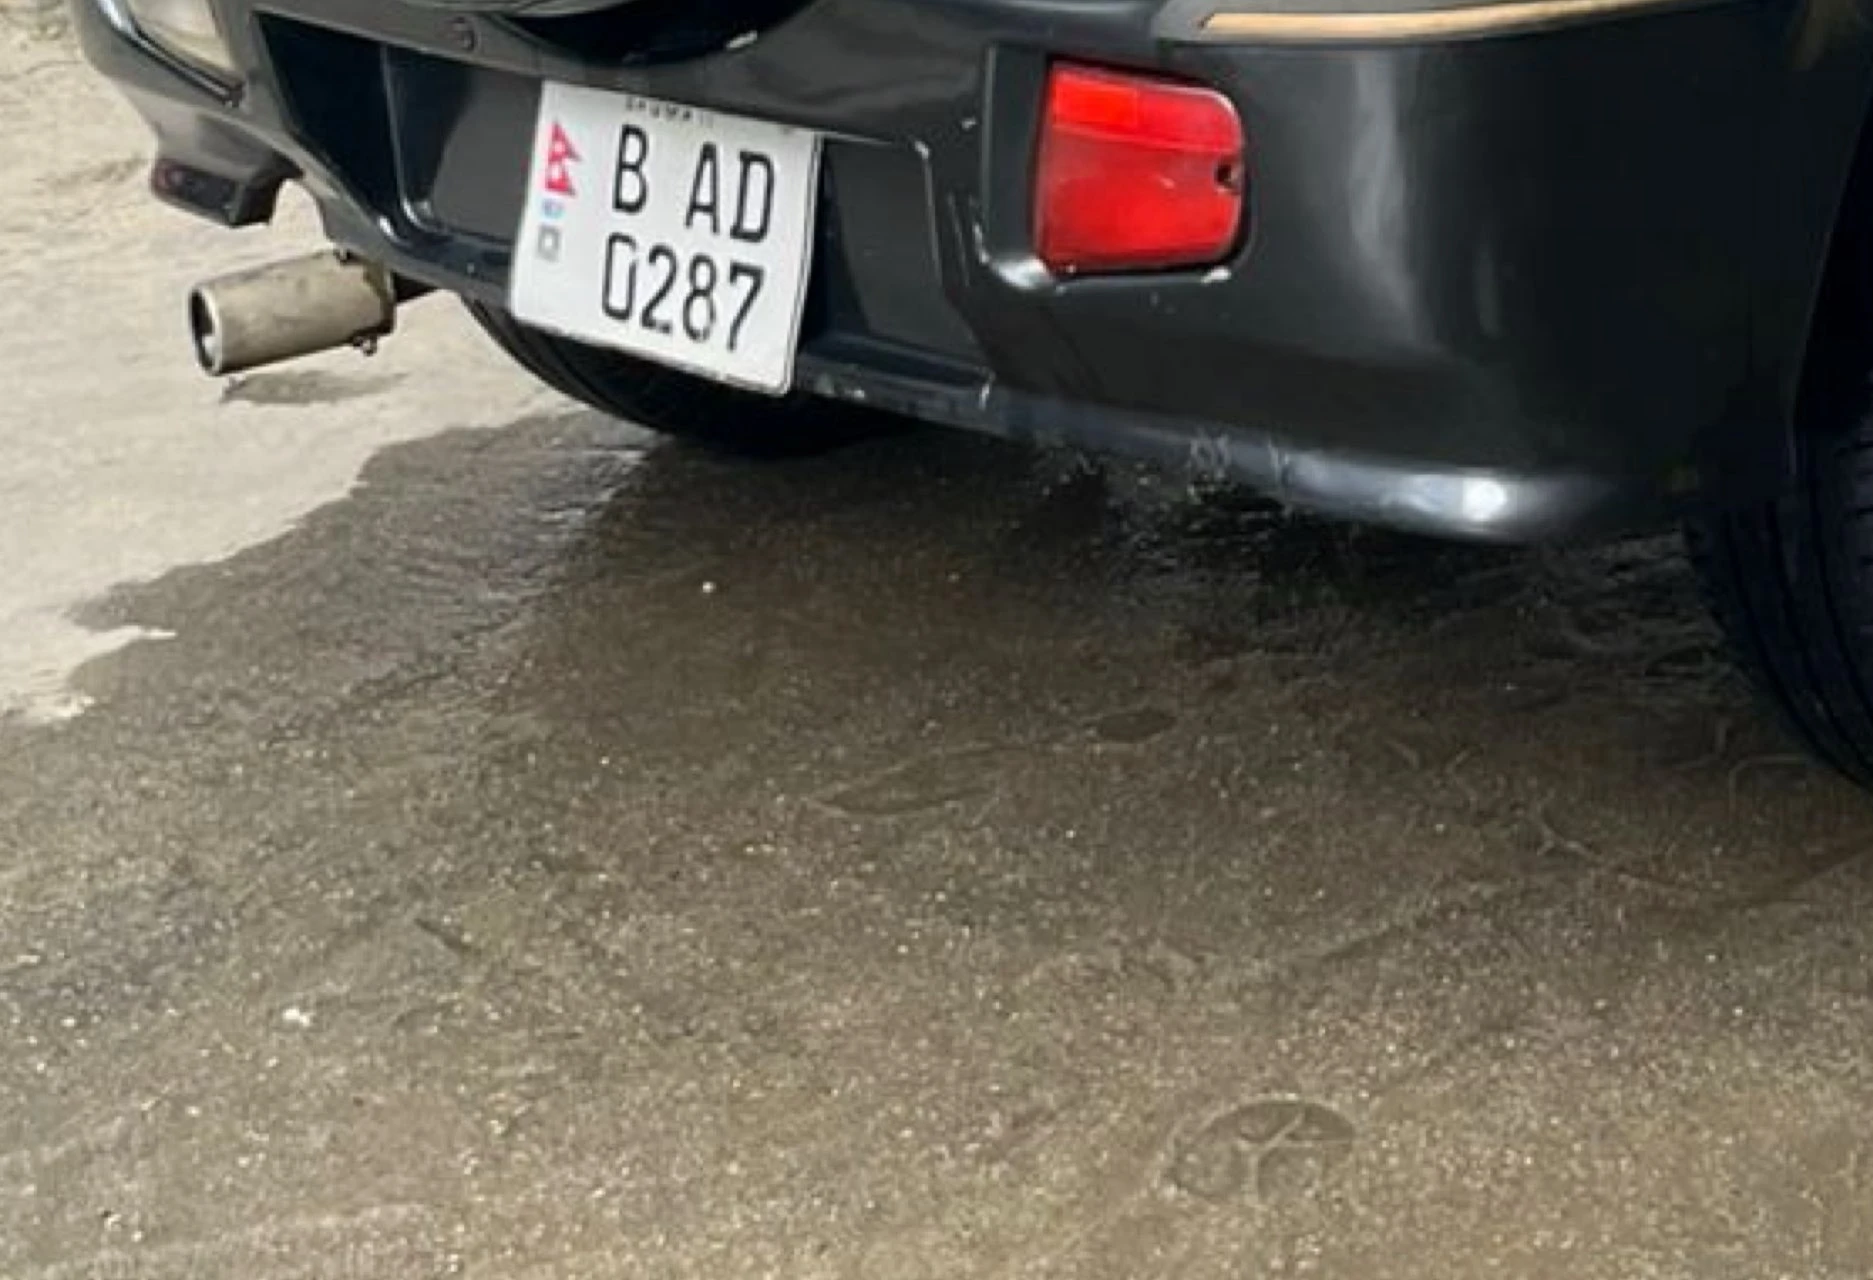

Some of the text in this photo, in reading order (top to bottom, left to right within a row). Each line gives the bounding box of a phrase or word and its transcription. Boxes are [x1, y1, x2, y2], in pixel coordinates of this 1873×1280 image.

[613, 124, 775, 243] B AD
[601, 231, 765, 352] 0287
